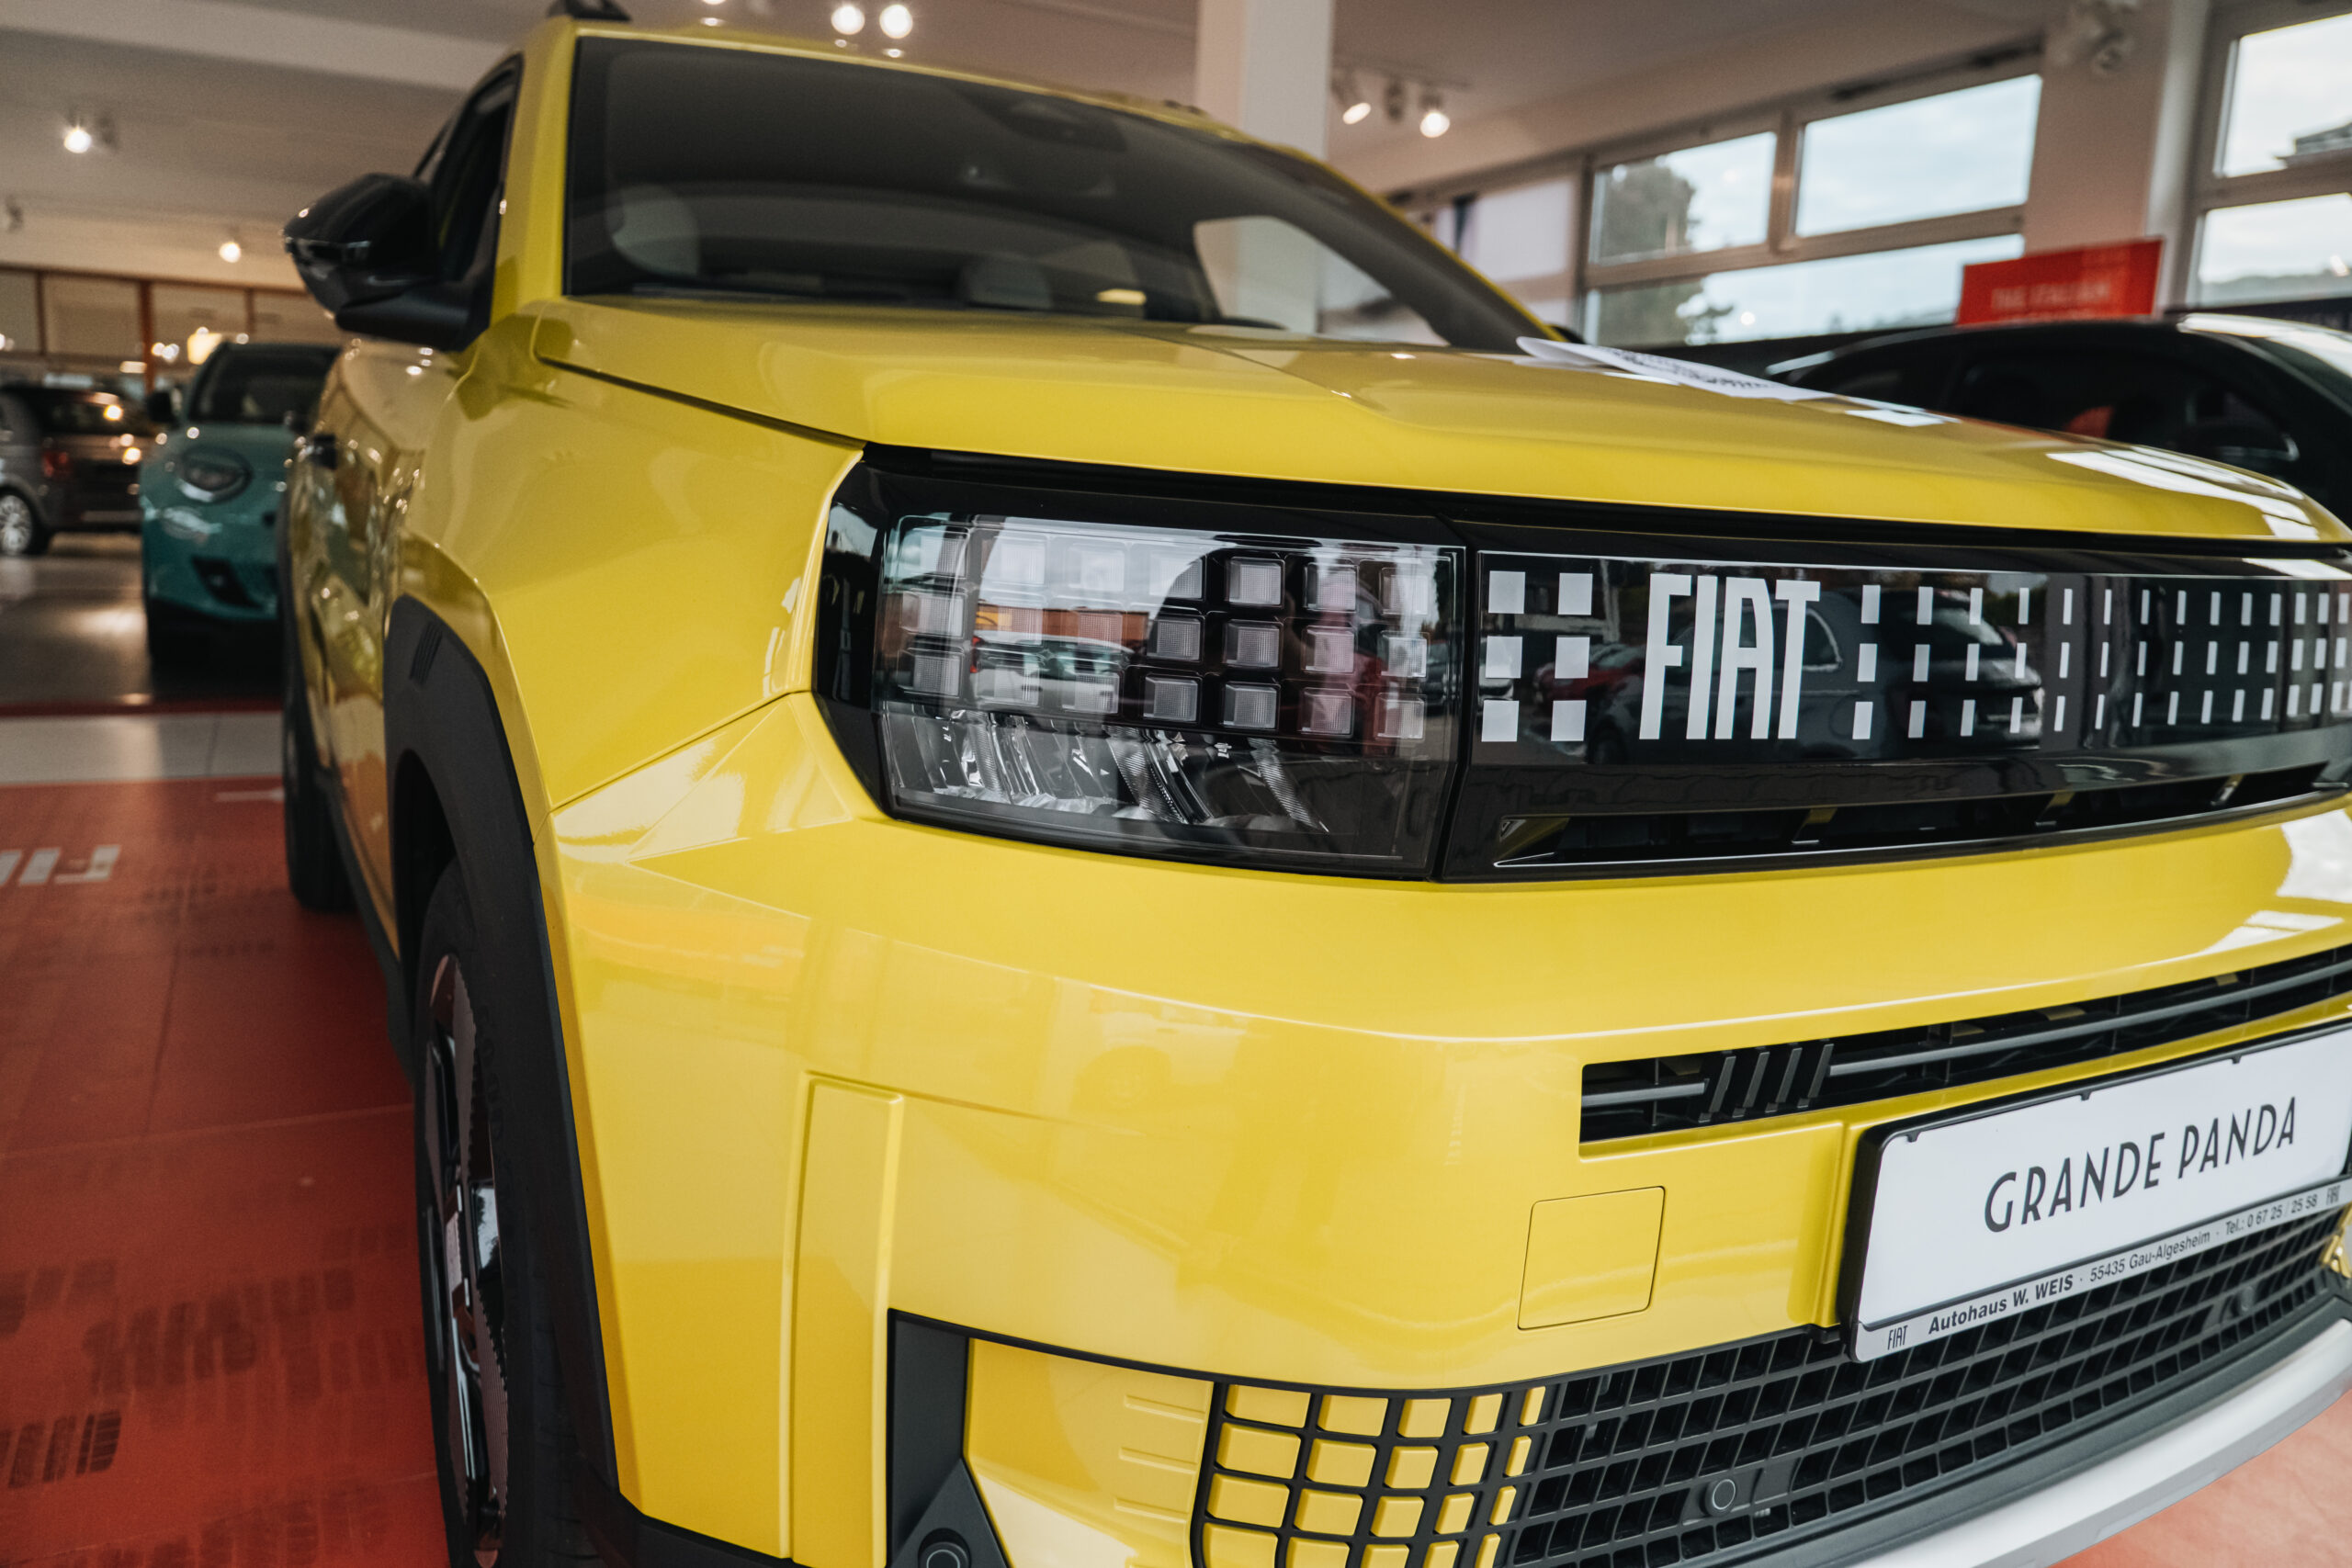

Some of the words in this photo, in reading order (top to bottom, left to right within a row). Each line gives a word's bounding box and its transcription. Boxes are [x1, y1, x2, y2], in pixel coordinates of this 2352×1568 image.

[1639, 573, 1820, 739] FIAT
[1984, 1132, 2165, 1233] GRANDE
[2177, 1097, 2295, 1179] PANDA
[1887, 1325, 1908, 1350] FIAT
[1928, 1298, 2007, 1335] Autohaus
[2013, 1289, 2030, 1307] W.
[2035, 1274, 2074, 1300] WEIS
[2090, 1258, 2125, 1282] 55435
[2129, 1231, 2211, 1269] Gau-Algesheim
[2225, 1218, 2244, 1235] Tel.:
[2246, 1214, 2254, 1228] 0
[2256, 1209, 2268, 1225] 67
[2270, 1205, 2283, 1220] 25
